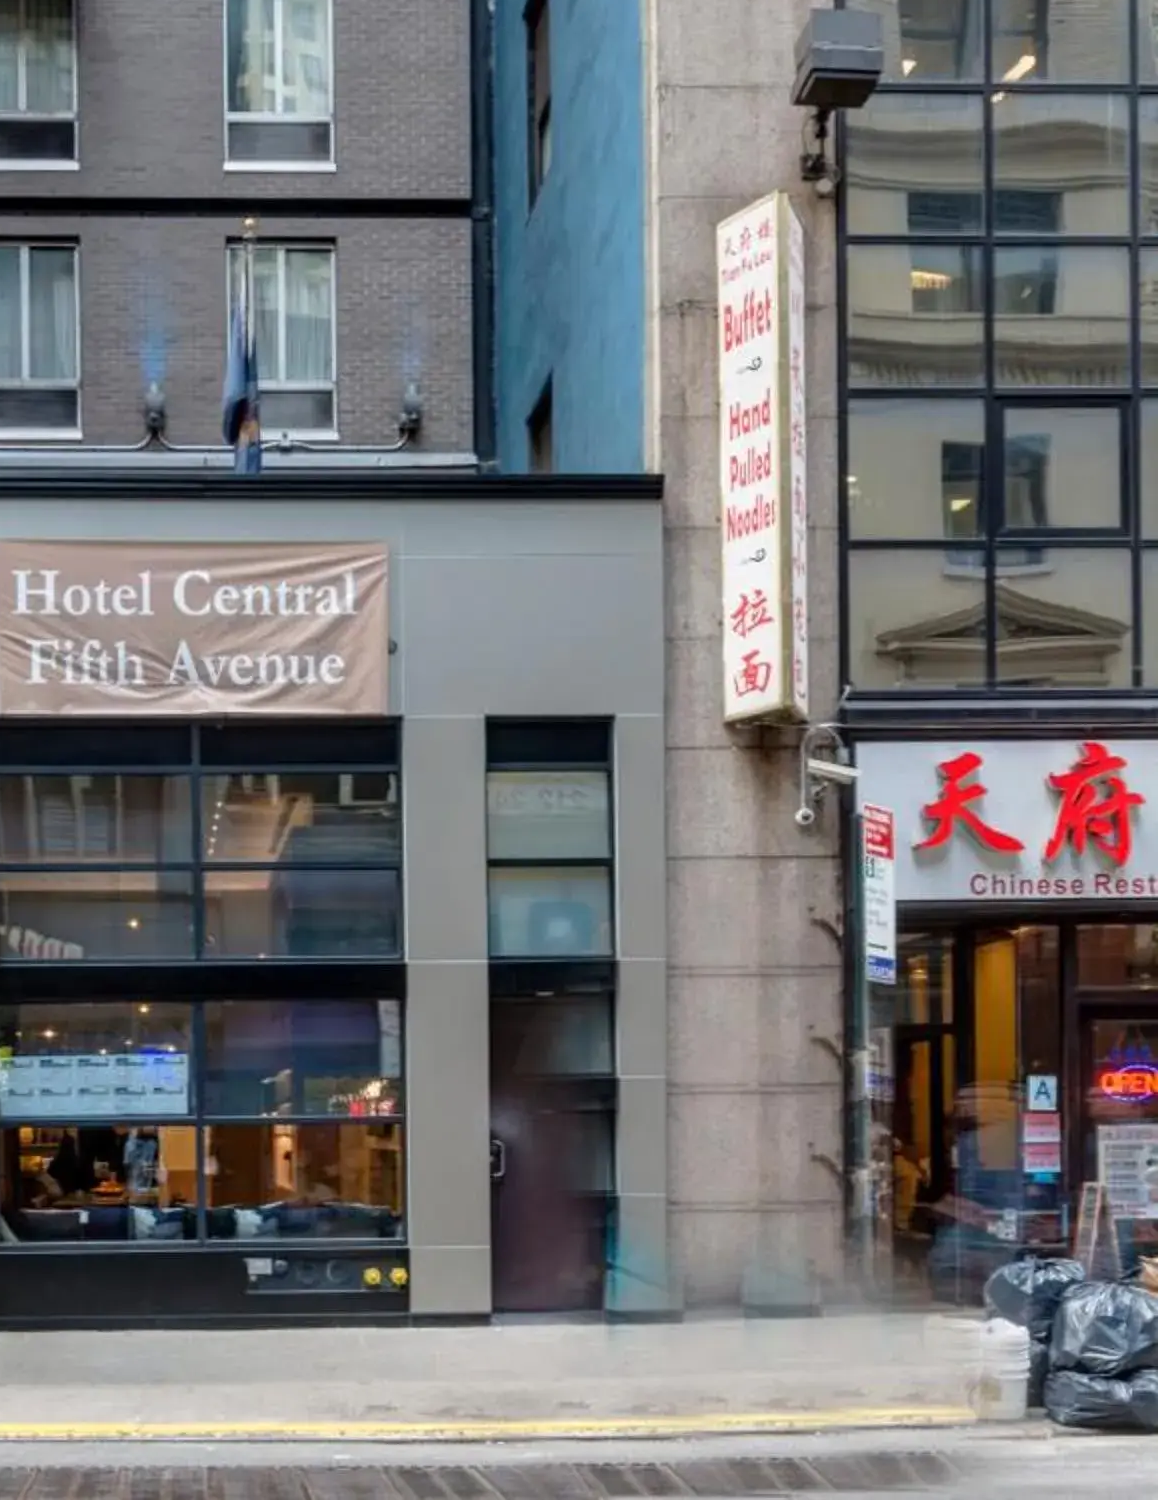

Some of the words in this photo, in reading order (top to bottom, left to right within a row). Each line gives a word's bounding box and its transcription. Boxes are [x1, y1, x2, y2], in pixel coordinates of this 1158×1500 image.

[724, 288, 771, 352] Buffet
[729, 388, 771, 441] Hand
[729, 442, 772, 492] Pulled
[727, 494, 776, 542] Noodles
[11, 569, 155, 617] Hotel
[173, 570, 357, 617] Central
[25, 639, 146, 686] Fifth
[168, 640, 346, 686] Avenue
[730, 589, 774, 697] 拉面
[911, 741, 1146, 868] 天府
[970, 873, 1084, 896] Chinese
[1094, 873, 1158, 896] Rest
[1034, 1079, 1051, 1101] A
[1101, 1072, 1158, 1093] OPEN
